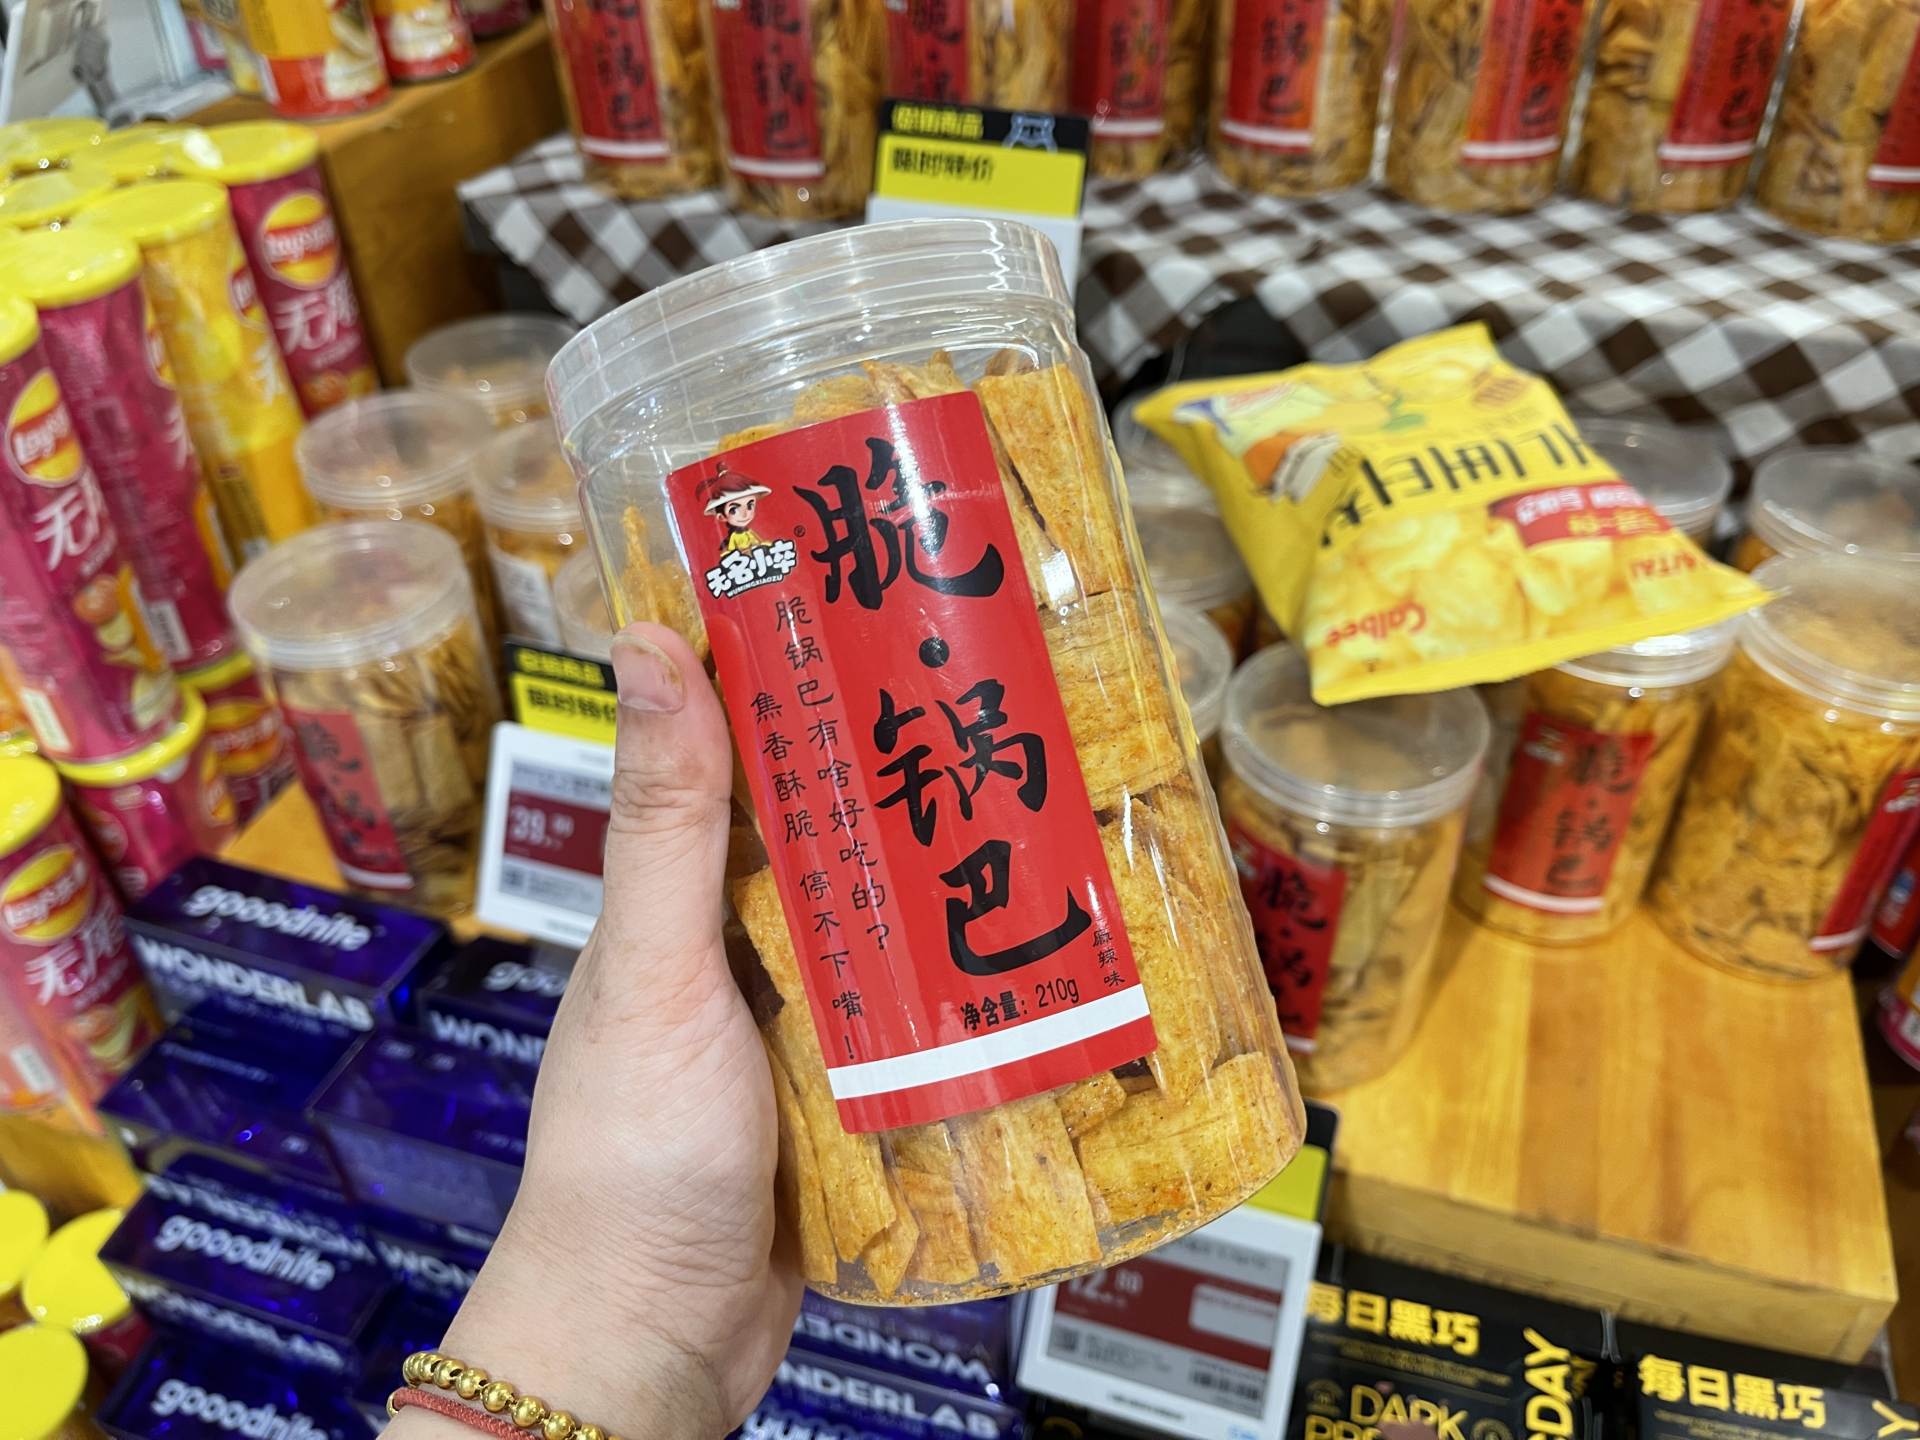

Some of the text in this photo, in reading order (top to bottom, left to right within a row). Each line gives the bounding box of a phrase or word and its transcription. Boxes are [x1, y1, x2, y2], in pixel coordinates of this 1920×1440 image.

[705, 540, 796, 598] 无名小卒
[1325, 597, 1427, 648] Calbee
[794, 437, 1092, 977] 脆·锅巴
[133, 932, 374, 1032] WONDERLAB
[1034, 977, 1082, 1010] 210g
[155, 1214, 335, 1291] gooodnite
[1637, 1353, 1827, 1430] 每日黑巧
